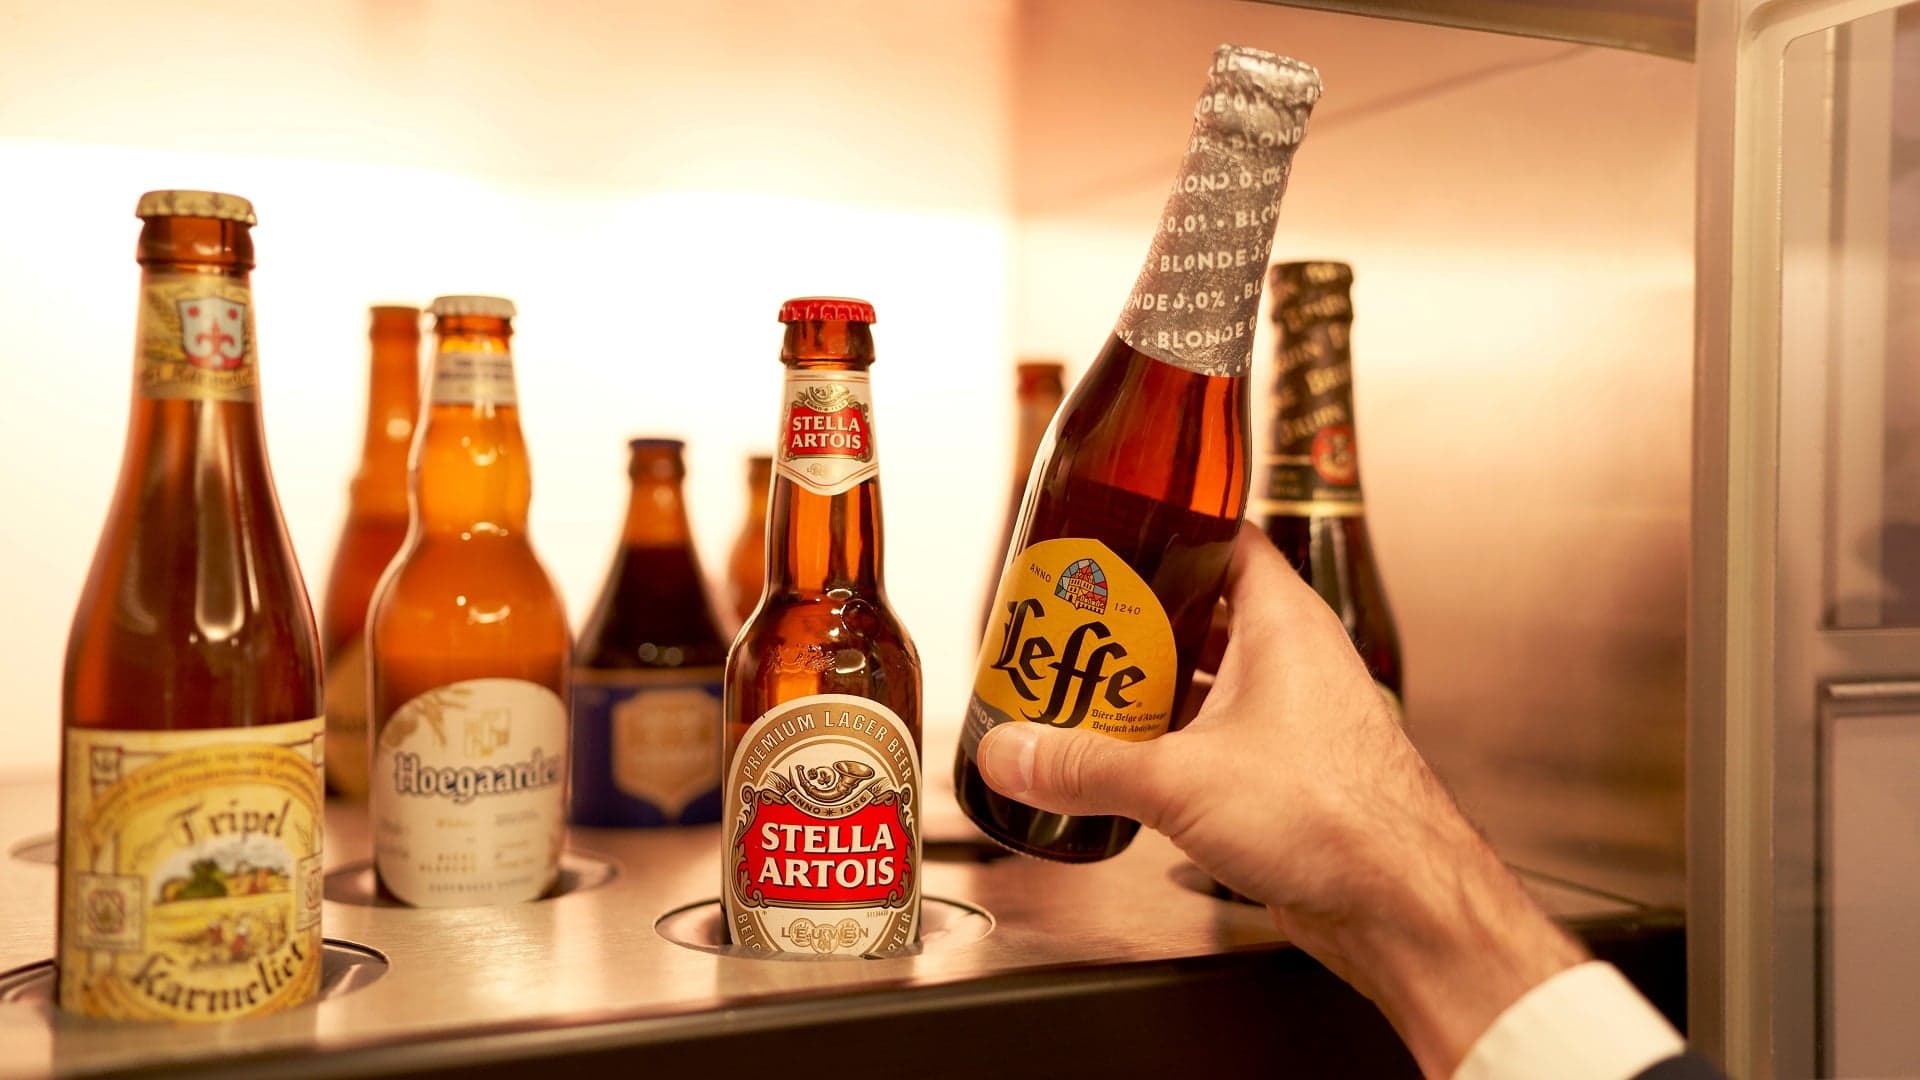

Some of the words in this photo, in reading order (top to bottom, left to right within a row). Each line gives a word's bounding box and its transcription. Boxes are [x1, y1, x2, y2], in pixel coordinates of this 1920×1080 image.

[1160, 249, 1247, 273] BLONDE
[1157, 320, 1244, 350] BLONDE
[792, 415, 861, 433] STELLA
[791, 432, 863, 450] ARTOIS
[1030, 563, 1052, 583] ANNO
[1114, 602, 1142, 616] 1240
[990, 598, 1147, 729] Leffe
[743, 713, 816, 780] PREMIUM
[824, 711, 888, 742] LAGER
[887, 737, 913, 782] BEER
[791, 794, 821, 815] ANNO
[167, 798, 291, 846] Tripel
[761, 822, 896, 854] STELLA
[758, 855, 896, 889] ARTOIS
[780, 926, 869, 938] LEUVEN
[131, 940, 304, 1013] Karmeliet
